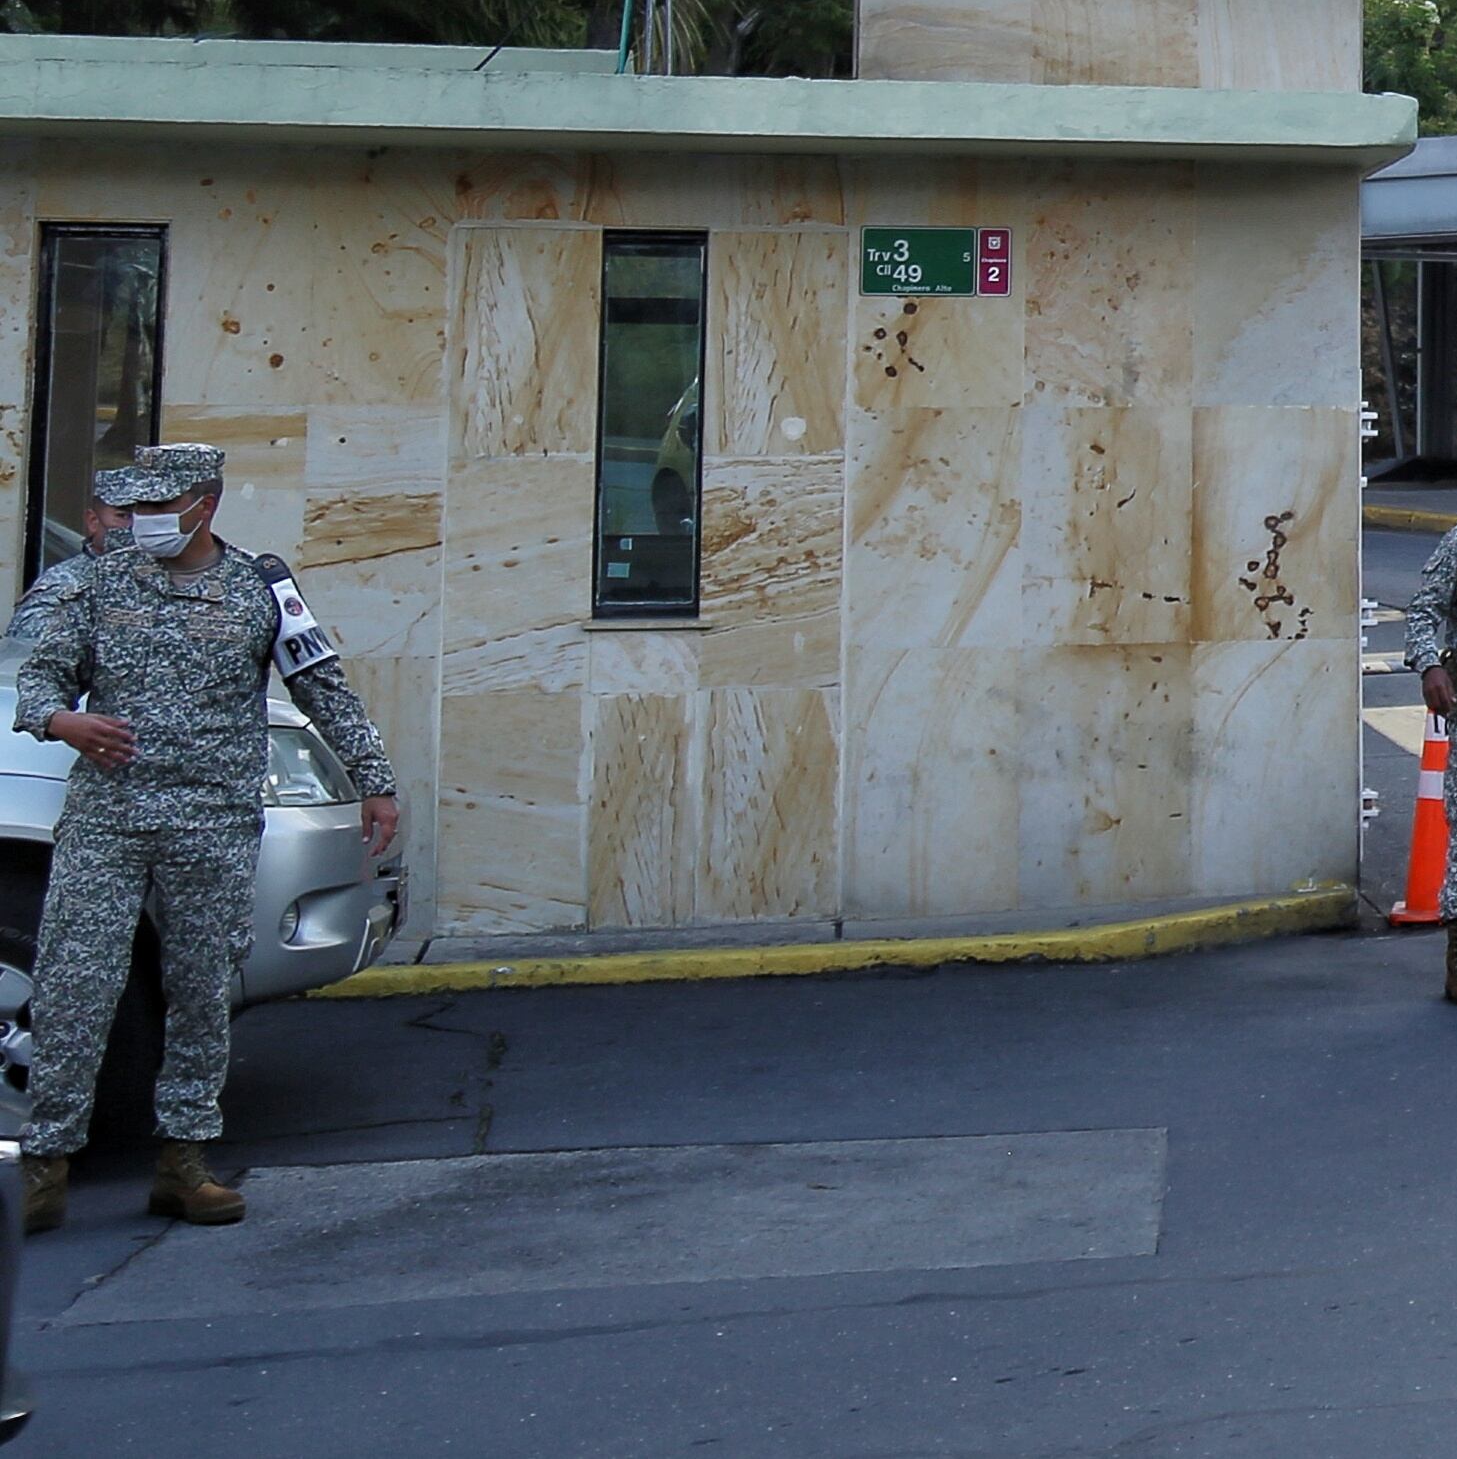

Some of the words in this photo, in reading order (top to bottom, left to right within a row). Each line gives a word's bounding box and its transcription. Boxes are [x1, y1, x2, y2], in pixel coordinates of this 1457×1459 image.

[867, 249, 891, 261] Trv
[893, 239, 909, 262] 3
[962, 252, 971, 262] 5
[893, 264, 922, 283] 49
[988, 266, 1000, 282] 2
